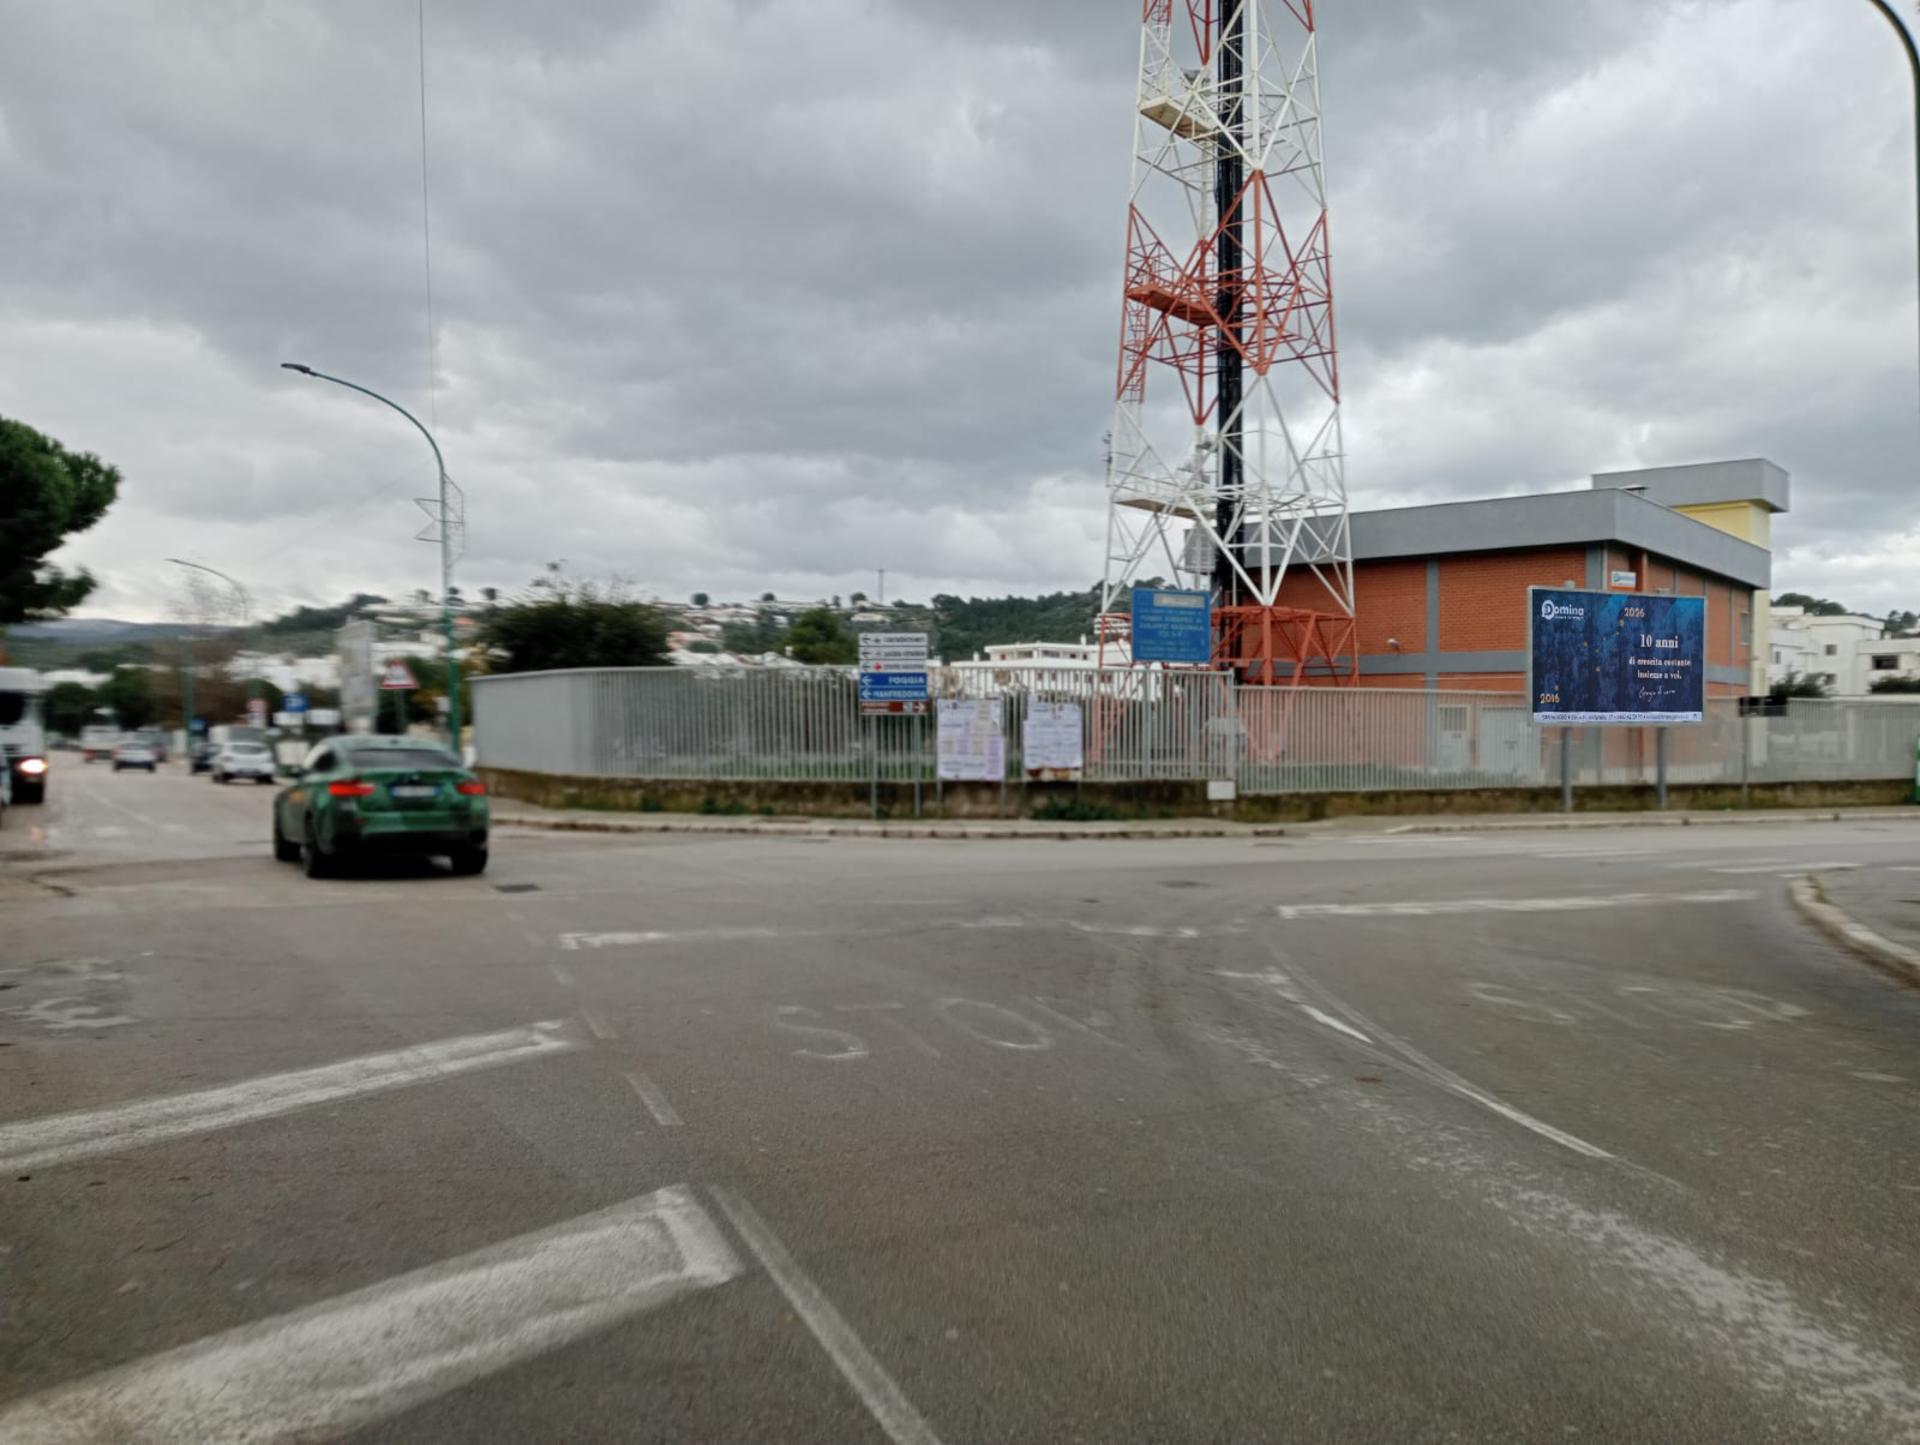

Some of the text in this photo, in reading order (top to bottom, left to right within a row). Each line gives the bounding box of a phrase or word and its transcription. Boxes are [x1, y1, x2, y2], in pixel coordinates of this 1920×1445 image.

[1541, 600, 1584, 620] Domina
[1623, 607, 1646, 618] 2026
[1639, 634, 1679, 649] 10 anni
[1628, 655, 1691, 668] di crescita costante
[1637, 669, 1663, 679] insieme
[888, 676, 925, 684] FOGGIA
[872, 690, 926, 698] MANFREDONIA
[1539, 693, 1561, 704] 2016
